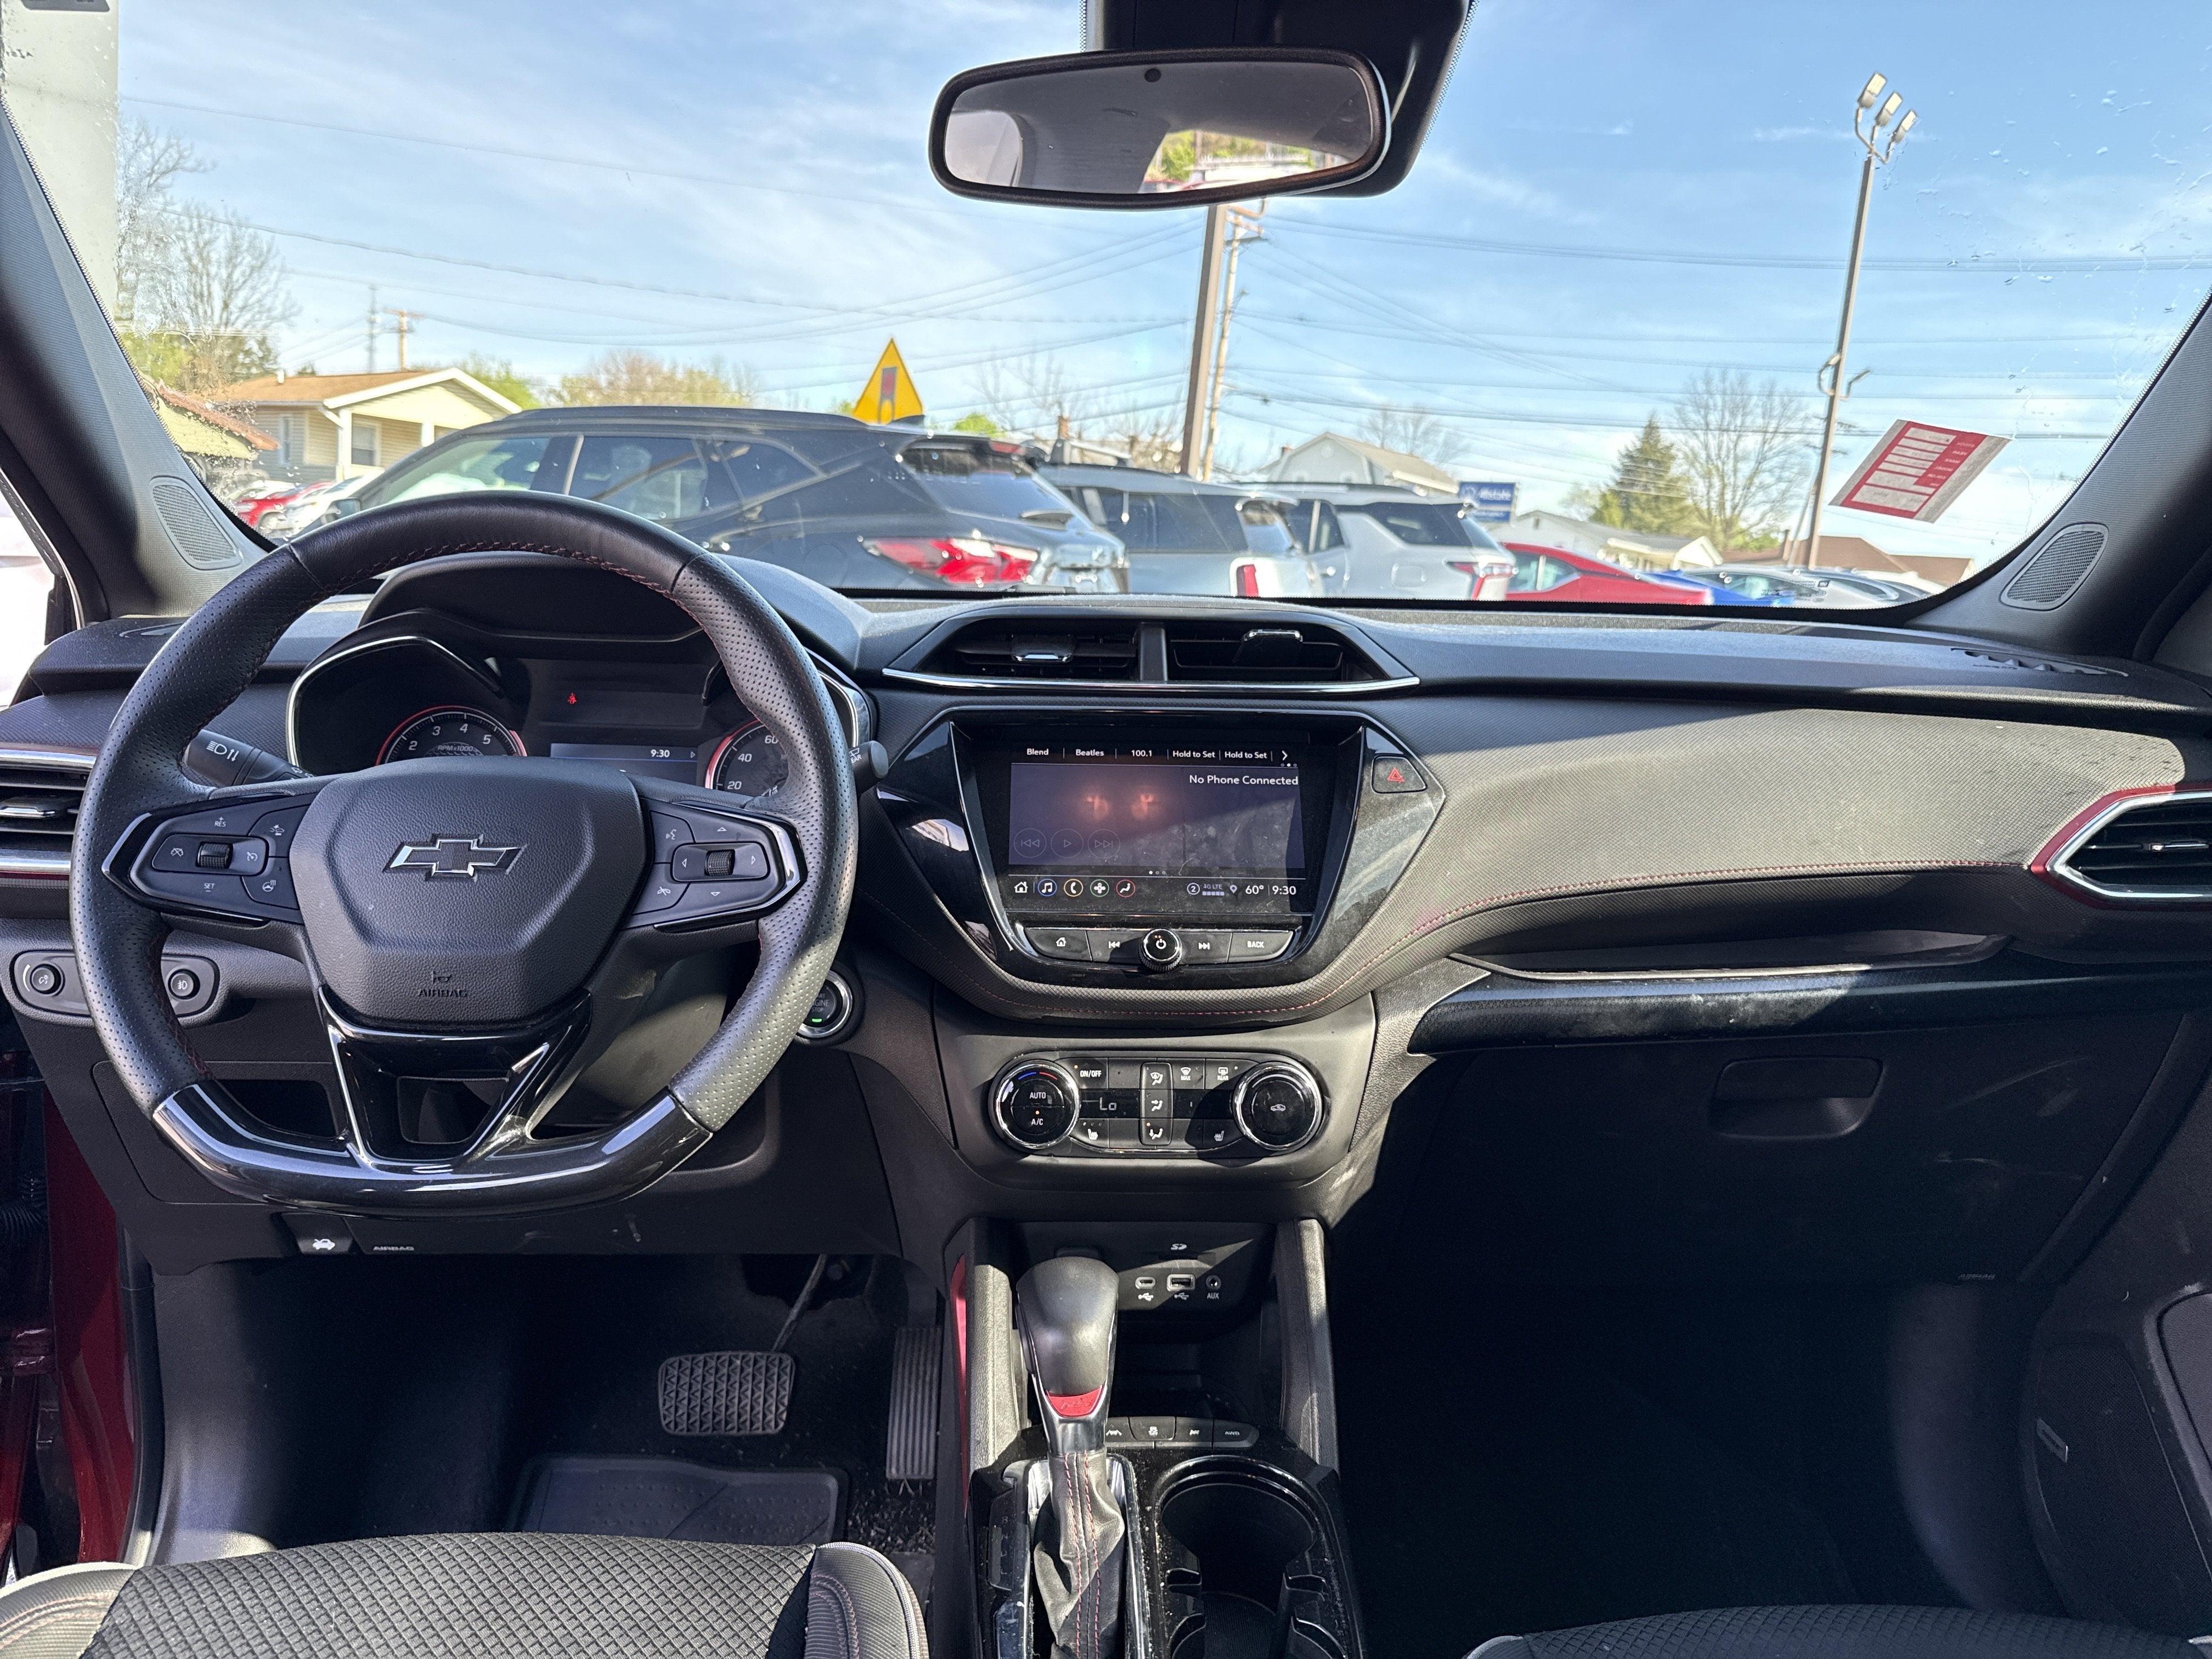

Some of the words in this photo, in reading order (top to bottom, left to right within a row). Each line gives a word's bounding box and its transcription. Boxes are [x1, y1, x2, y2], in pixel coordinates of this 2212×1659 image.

[409, 741, 417, 751] 2
[432, 726, 441, 736] 3
[459, 723, 469, 733] 4
[483, 734, 492, 744] 5
[764, 735, 778, 743] 60
[651, 748, 670, 759] 9:30
[738, 753, 752, 763] 40
[727, 780, 742, 790] 20
[1189, 775, 1204, 784] No
[1207, 775, 1239, 784] Phone
[1242, 776, 1299, 786] Connected
[1272, 885, 1296, 895] 9:30
[1247, 940, 1265, 949] BACK
[418, 988, 467, 997] AIRBAG
[1080, 1070, 1102, 1078] ON/OFF
[1029, 1092, 1046, 1100] AUTO
[1031, 1118, 1044, 1126] A/C
